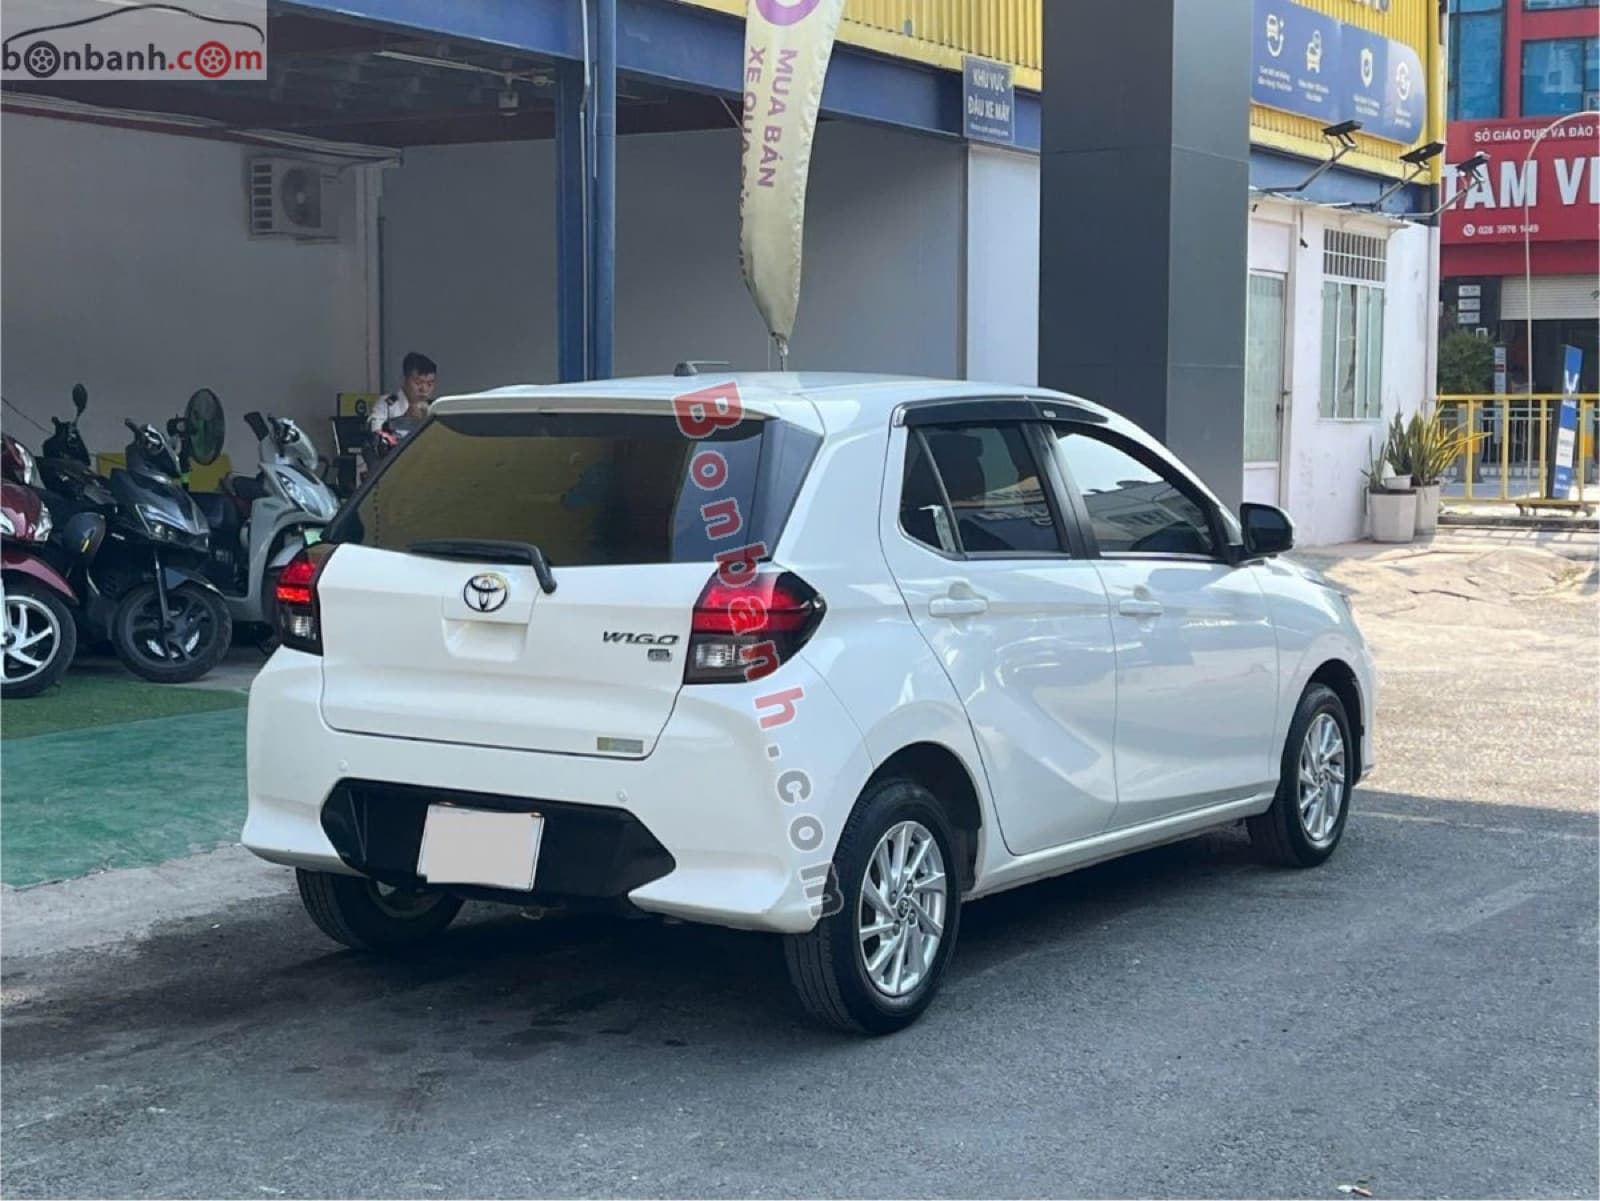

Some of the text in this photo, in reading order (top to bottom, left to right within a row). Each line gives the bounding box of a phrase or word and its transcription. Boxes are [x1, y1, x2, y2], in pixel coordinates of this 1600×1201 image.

[746, 47, 766, 84] XE
[757, 48, 799, 188] MUA BÁN
[1492, 127, 1521, 141] GIÁO
[602, 631, 680, 646] WIGO
